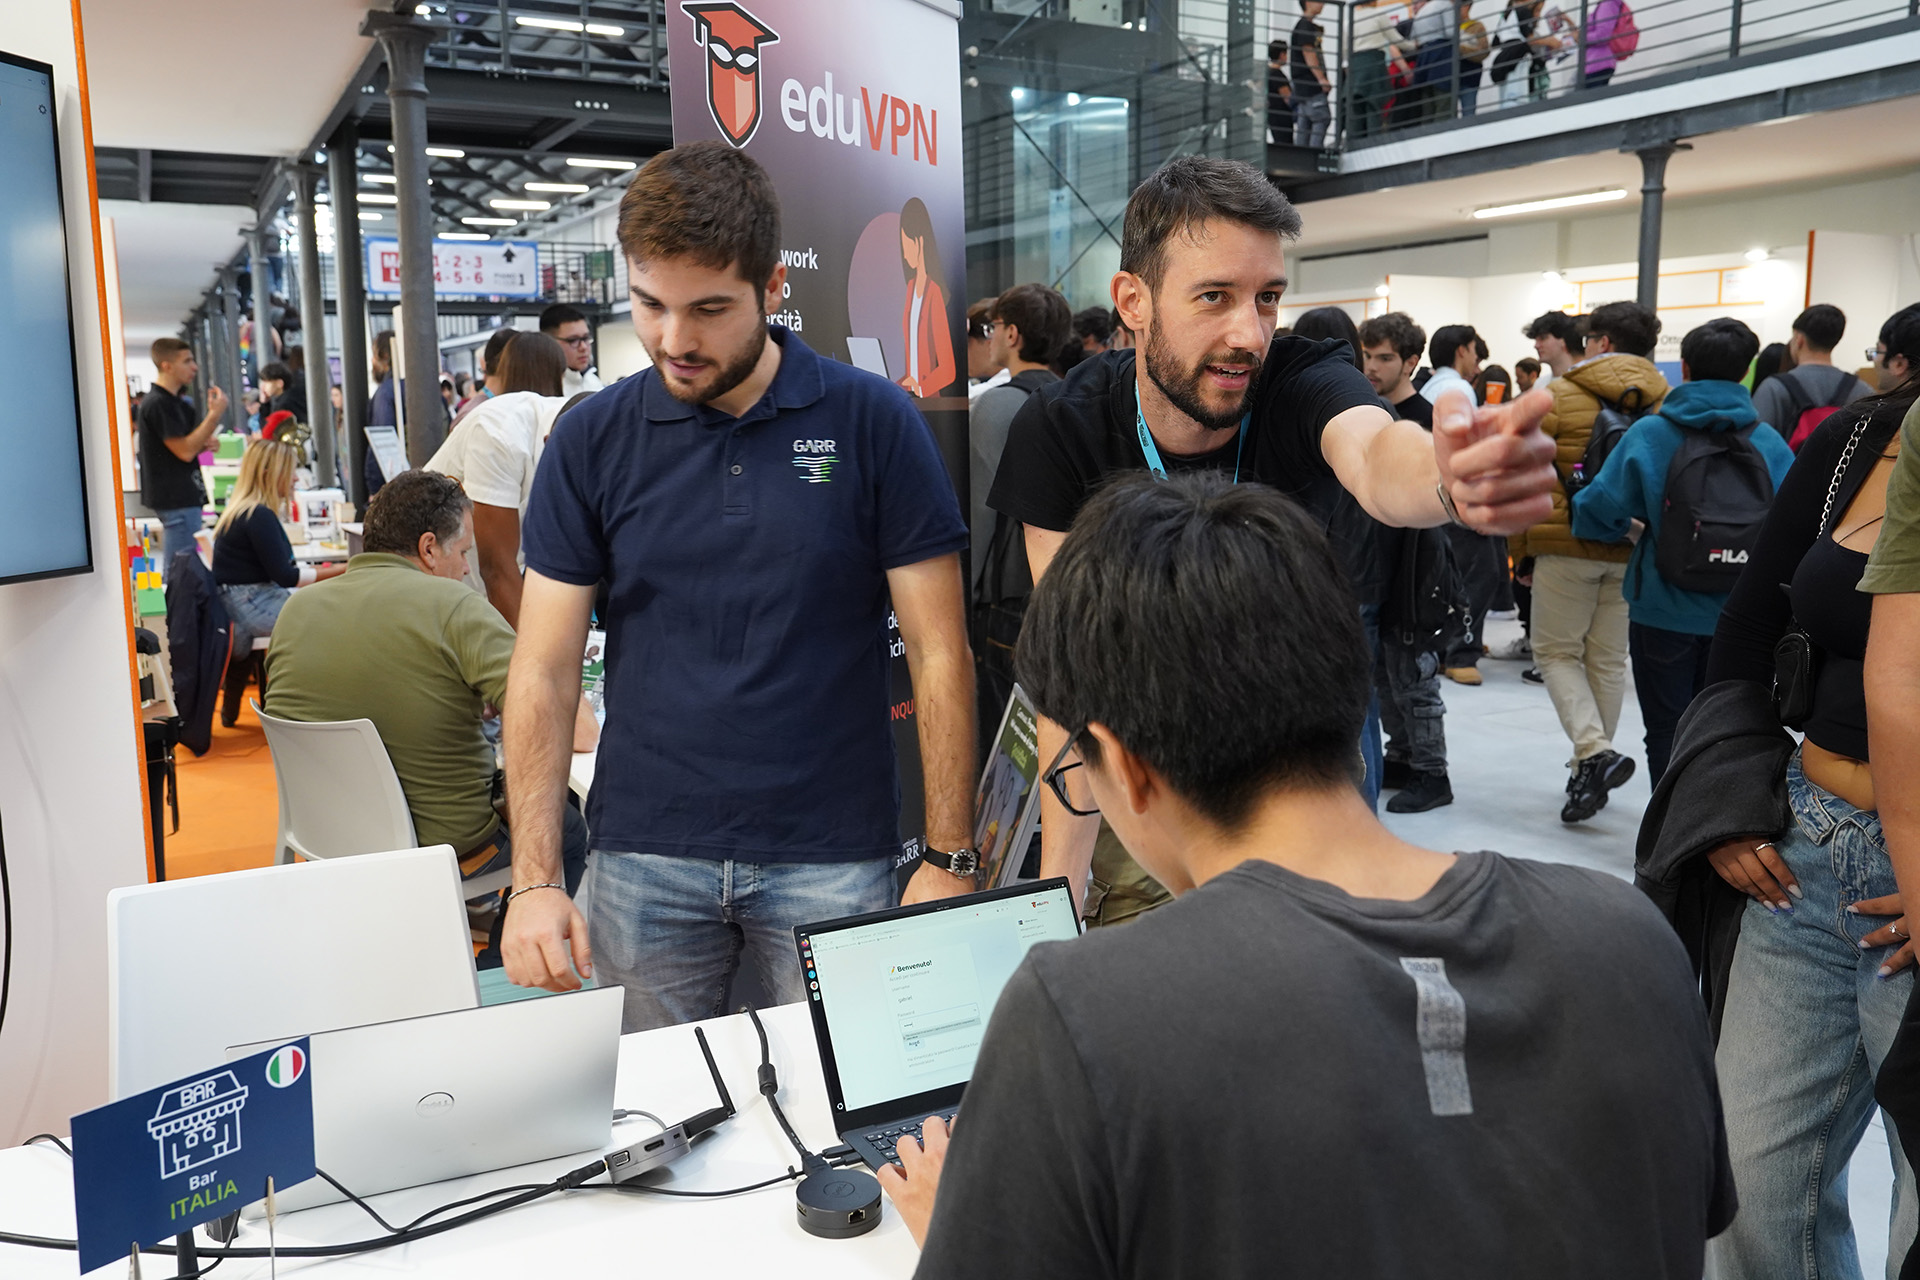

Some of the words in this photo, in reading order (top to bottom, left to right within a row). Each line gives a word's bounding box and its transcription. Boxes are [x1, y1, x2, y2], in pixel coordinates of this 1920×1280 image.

[780, 70, 937, 167] eduVPN
[780, 247, 819, 270] work
[766, 309, 803, 332] rsità
[793, 439, 837, 453] GARR
[1708, 549, 1749, 564] FILA
[897, 960, 933, 972] Benvenuto!
[179, 1079, 217, 1108] BAR
[188, 1170, 218, 1192] Bar
[170, 1179, 239, 1221] ITALIA
